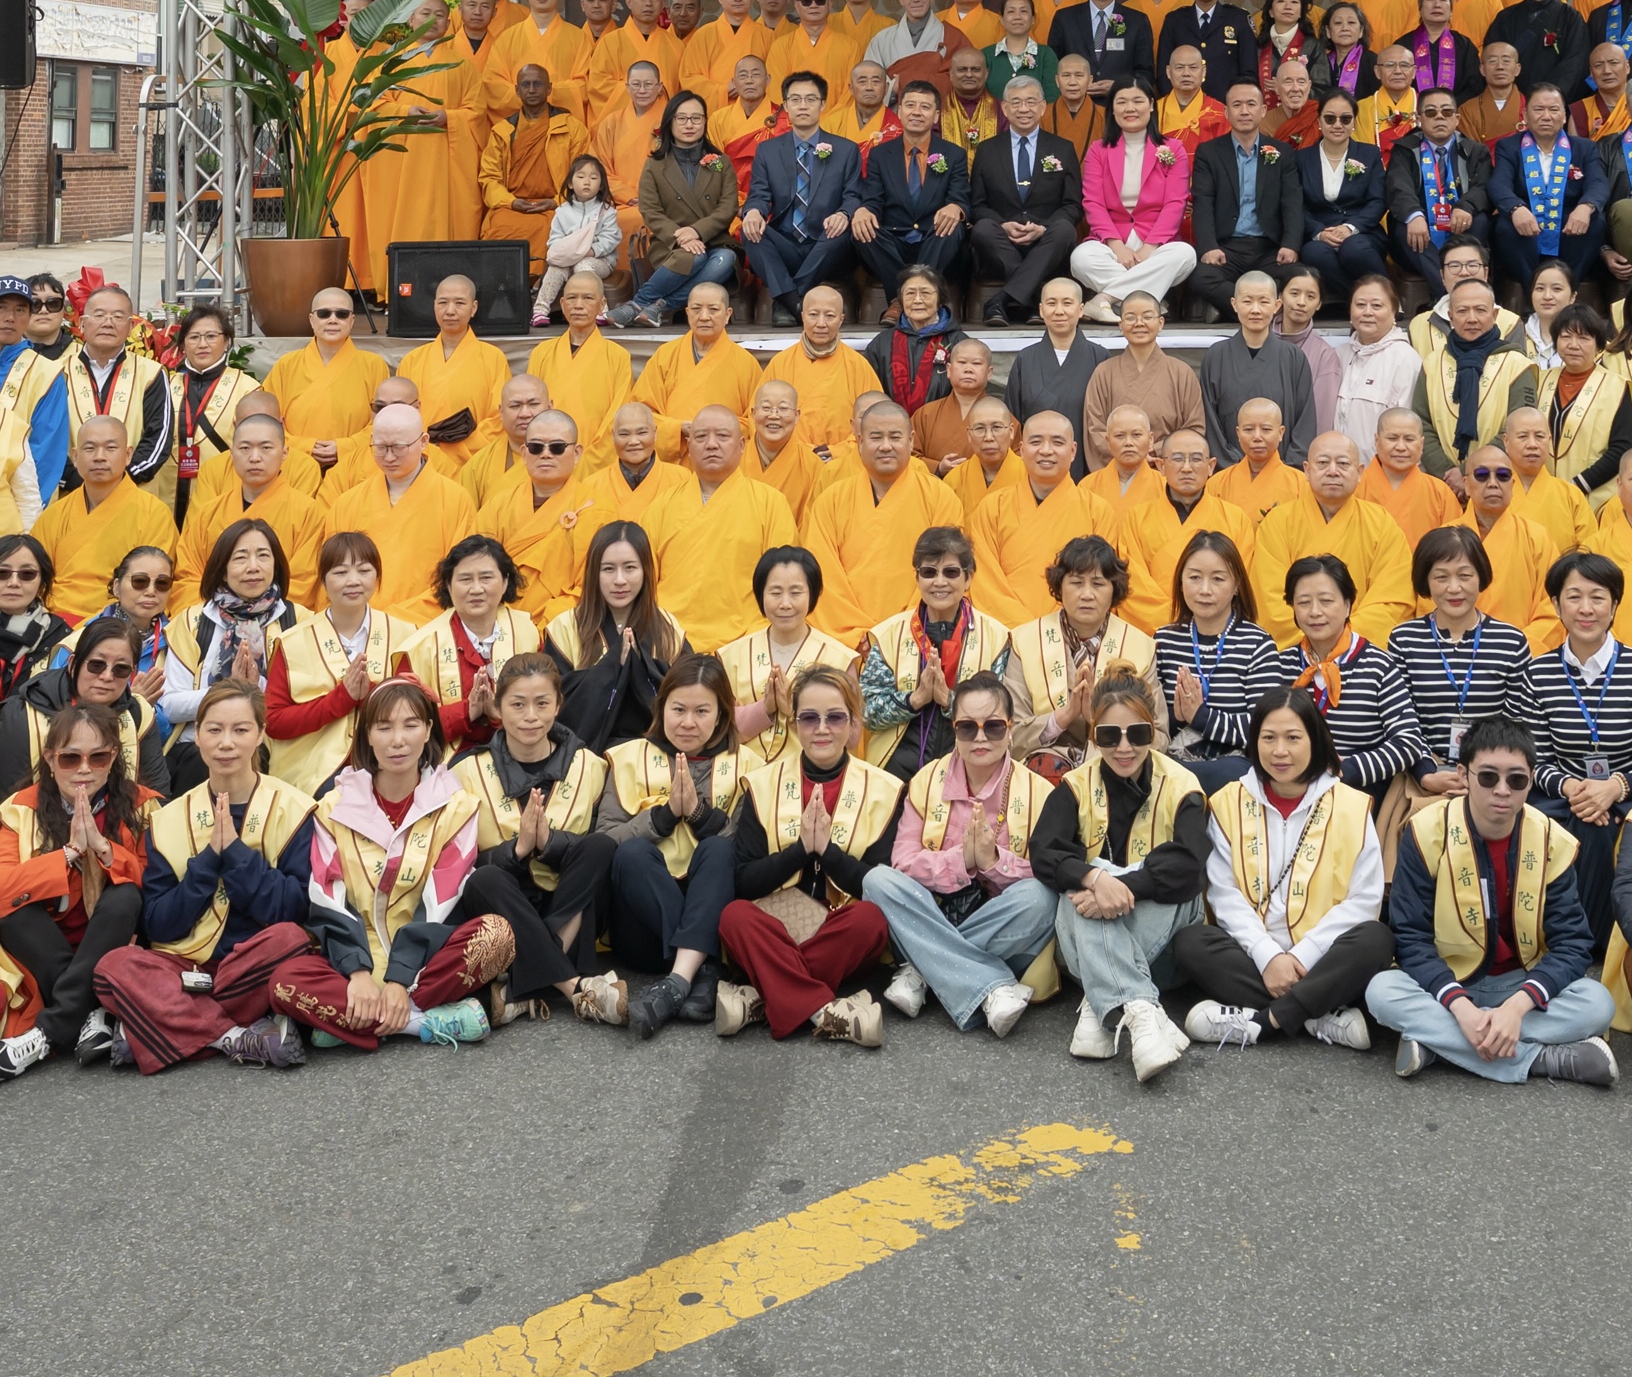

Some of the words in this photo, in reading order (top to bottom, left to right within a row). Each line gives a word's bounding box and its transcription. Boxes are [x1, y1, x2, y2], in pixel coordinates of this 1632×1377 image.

[1449, 822, 1480, 926] 梵音寺
[1516, 849, 1539, 947] 普陀山
